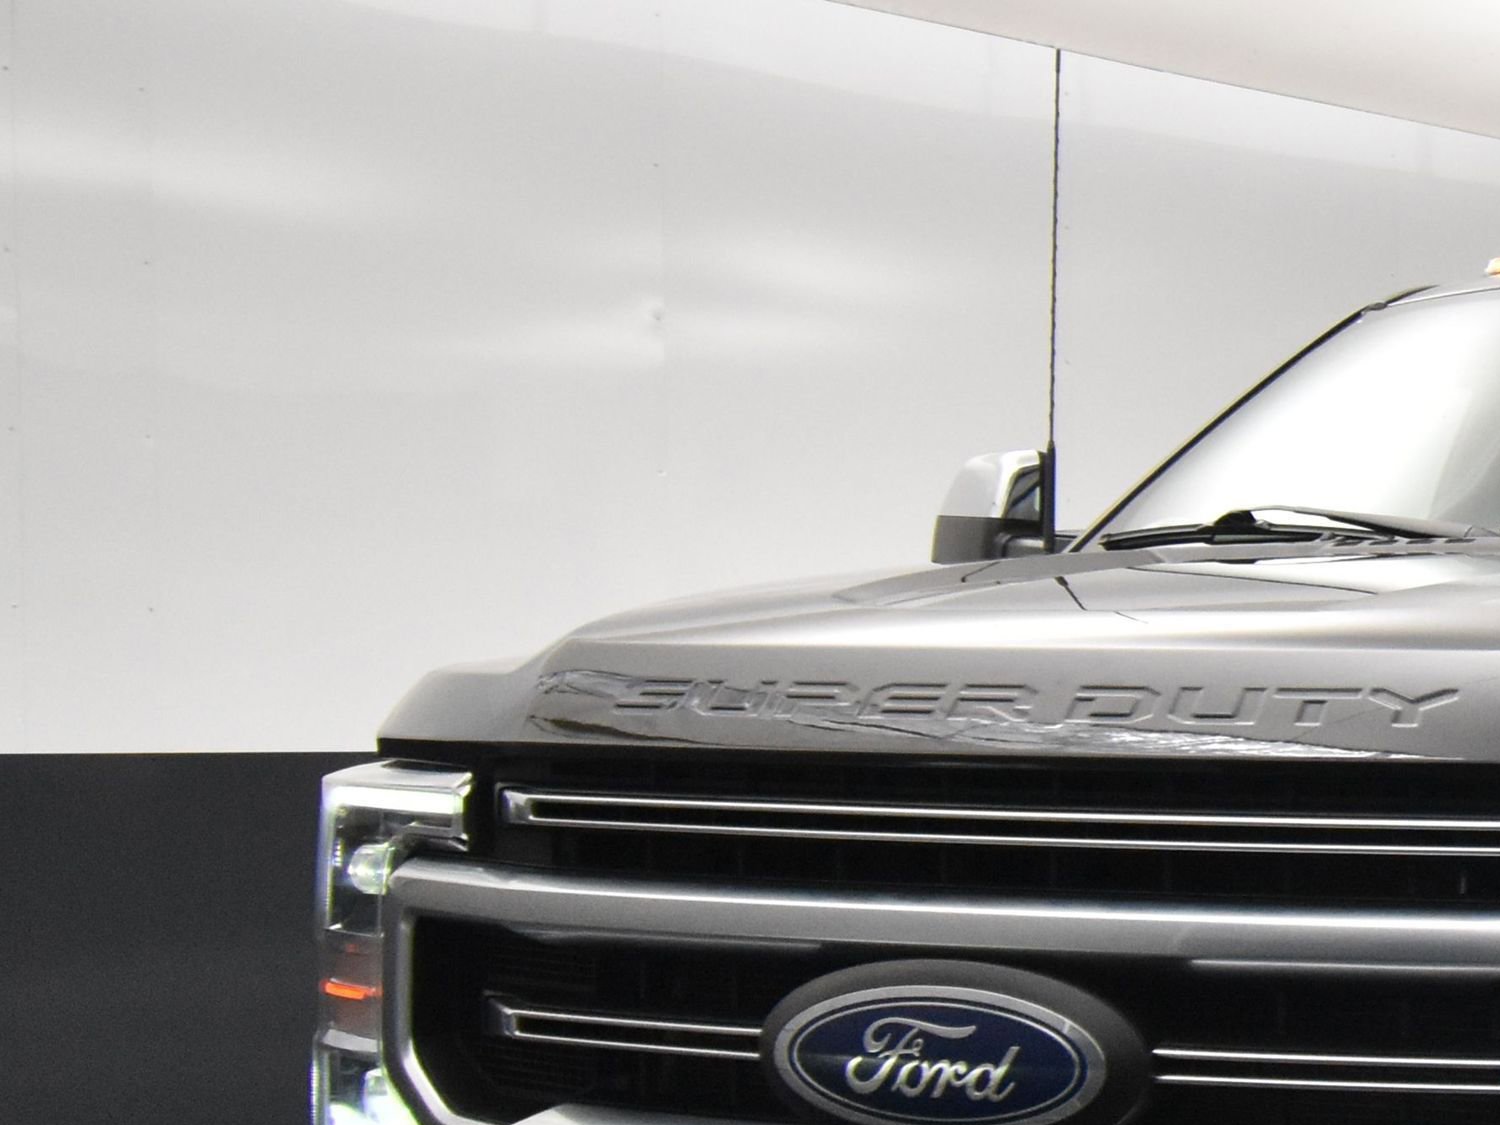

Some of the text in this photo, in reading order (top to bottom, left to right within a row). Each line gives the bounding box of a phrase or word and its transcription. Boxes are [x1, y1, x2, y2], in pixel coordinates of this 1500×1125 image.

[612, 677, 1461, 729] SUPER DUTY
[845, 1016, 1022, 1102] Ford
